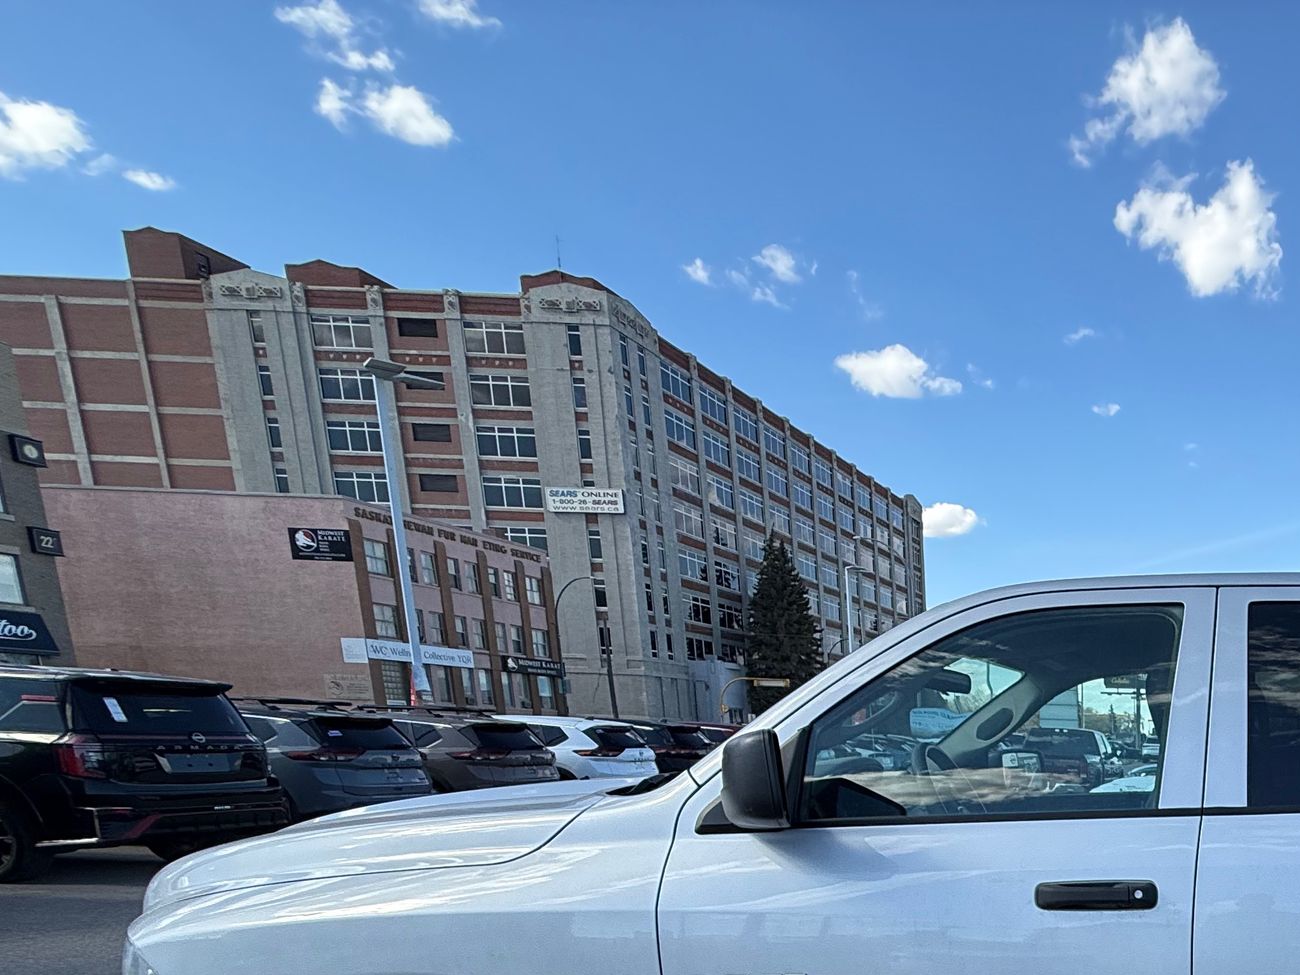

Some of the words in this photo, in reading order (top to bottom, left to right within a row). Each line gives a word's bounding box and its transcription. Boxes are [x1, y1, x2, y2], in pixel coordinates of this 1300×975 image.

[549, 489, 577, 497] SEARS
[437, 528, 456, 541] FUR
[510, 548, 541, 563] SERVICE
[423, 651, 456, 661] Collective
